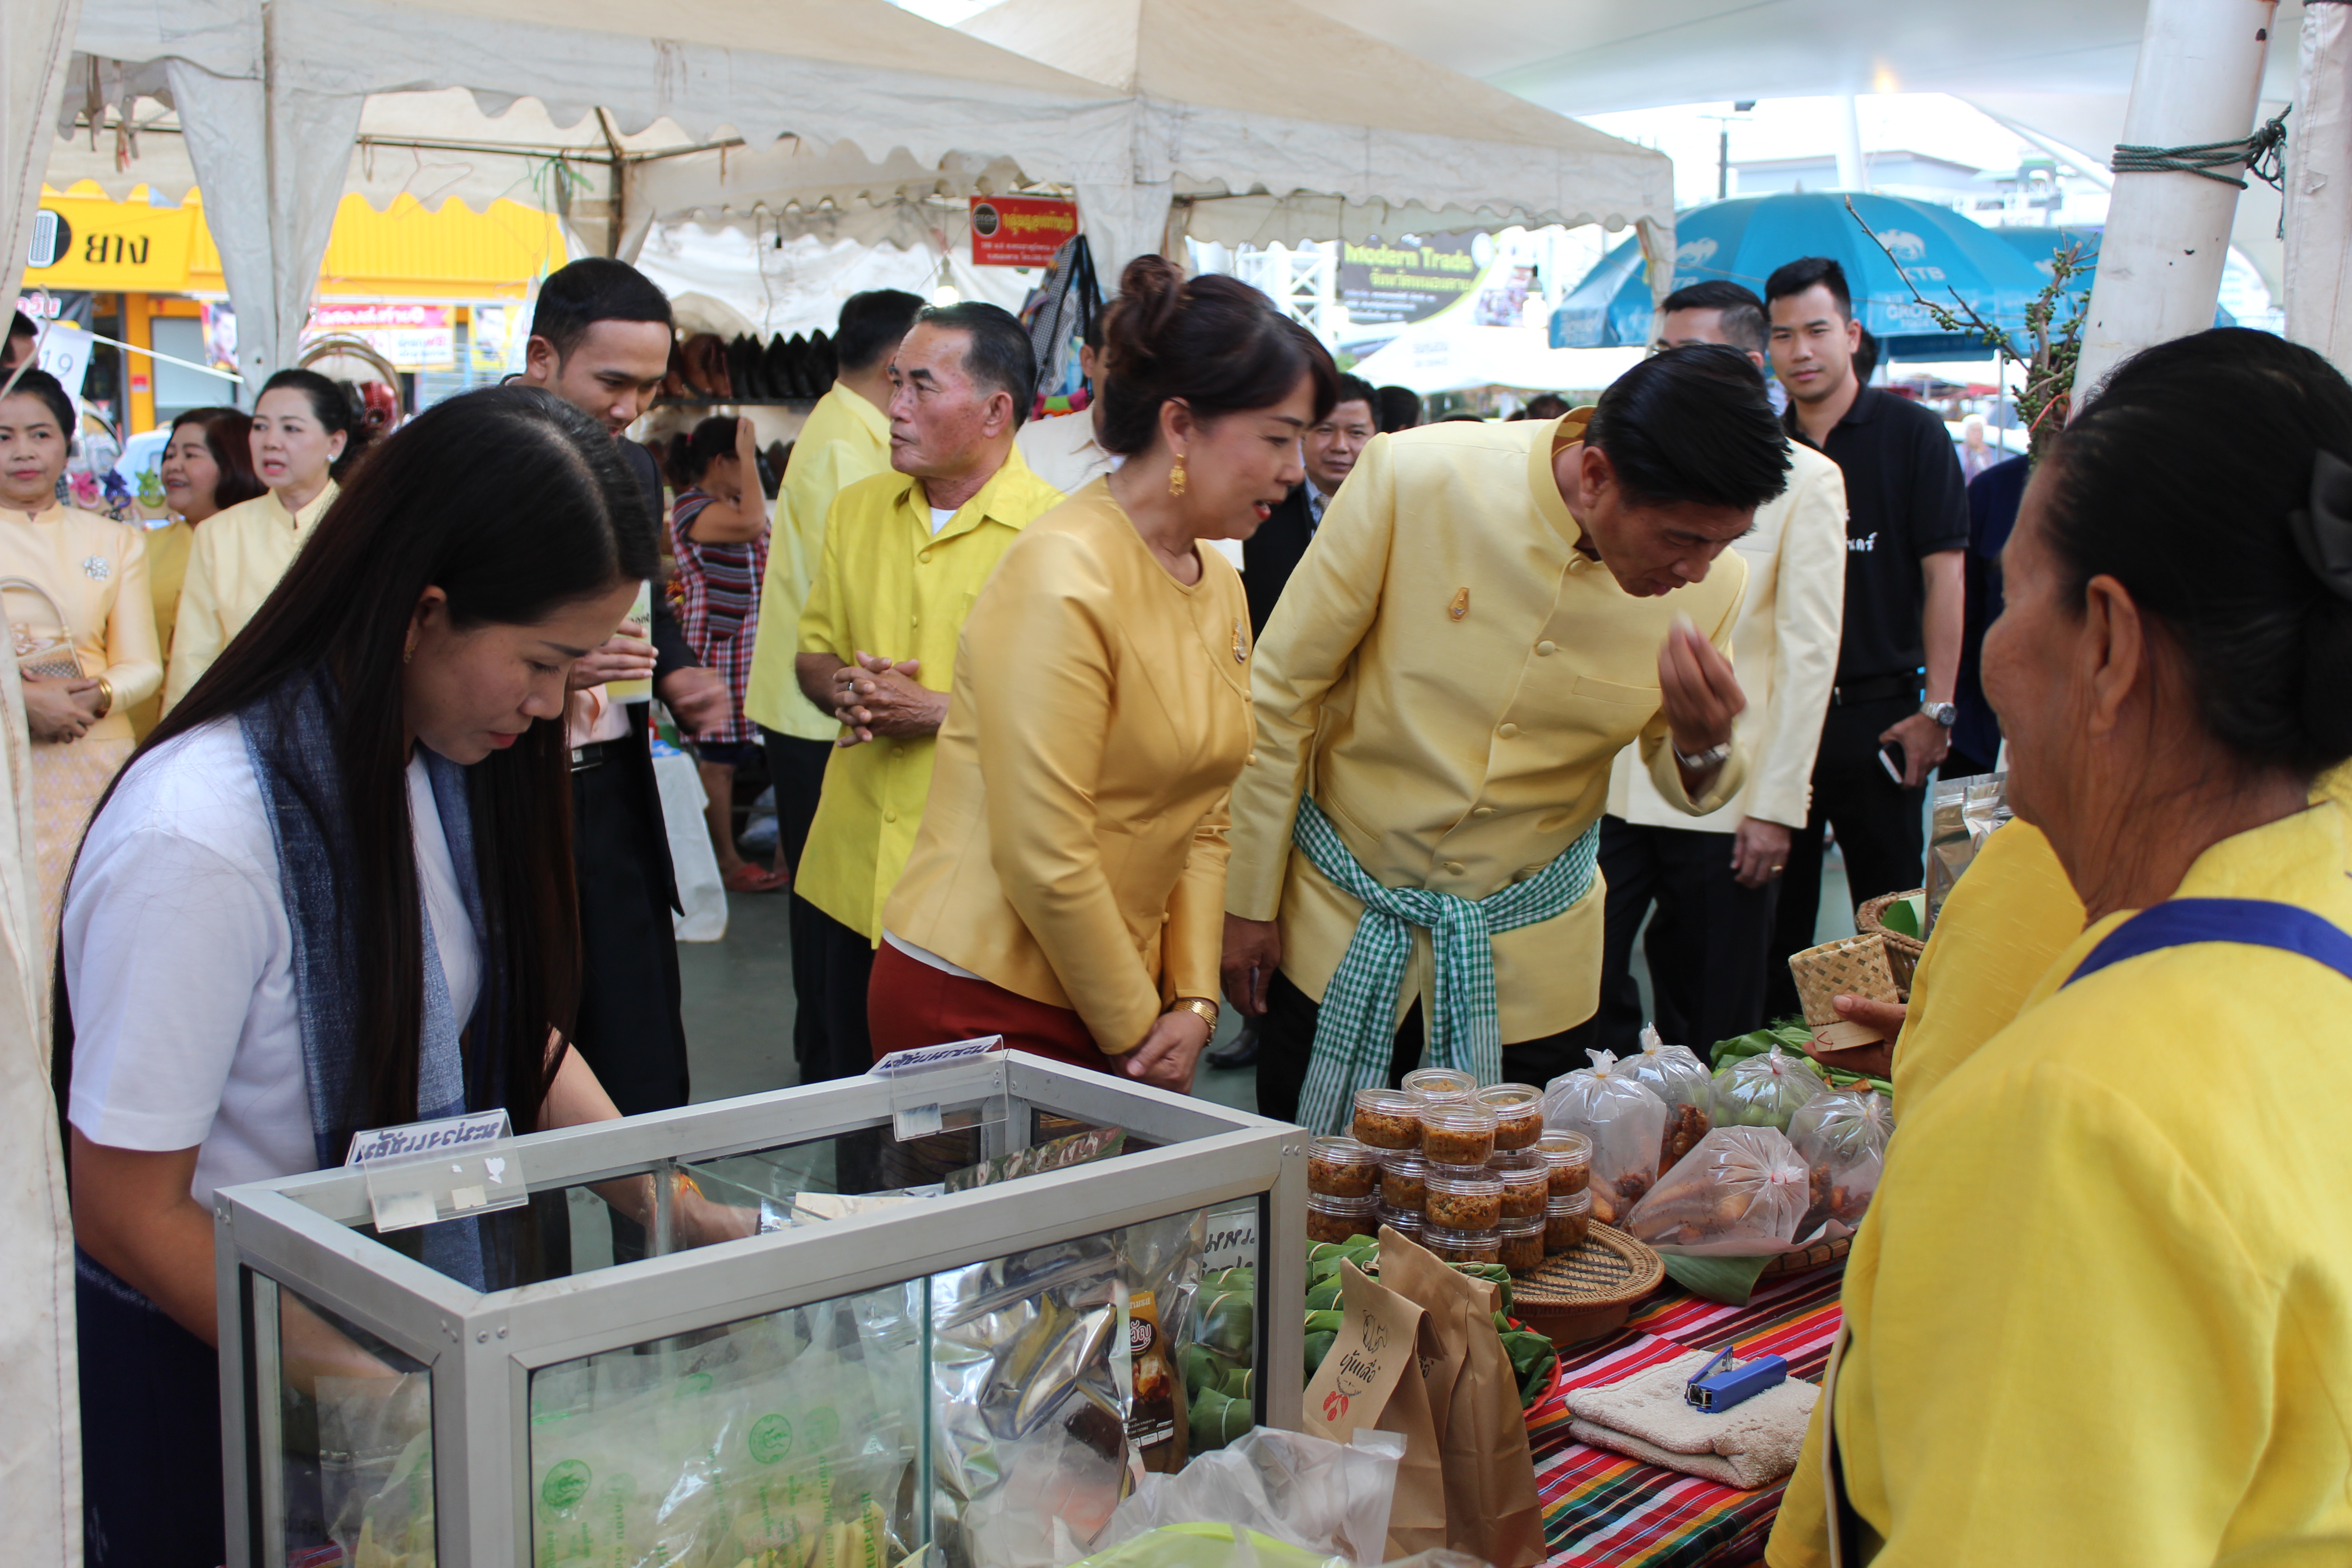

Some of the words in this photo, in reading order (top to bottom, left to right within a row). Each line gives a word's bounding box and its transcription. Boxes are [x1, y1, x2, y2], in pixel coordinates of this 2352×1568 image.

[85, 233, 149, 264] ยาง
[1344, 243, 1419, 269] Modern
[1420, 247, 1473, 273] Trade
[1896, 266, 1946, 281] KTB
[1130, 1320, 1152, 1348] วัญ
